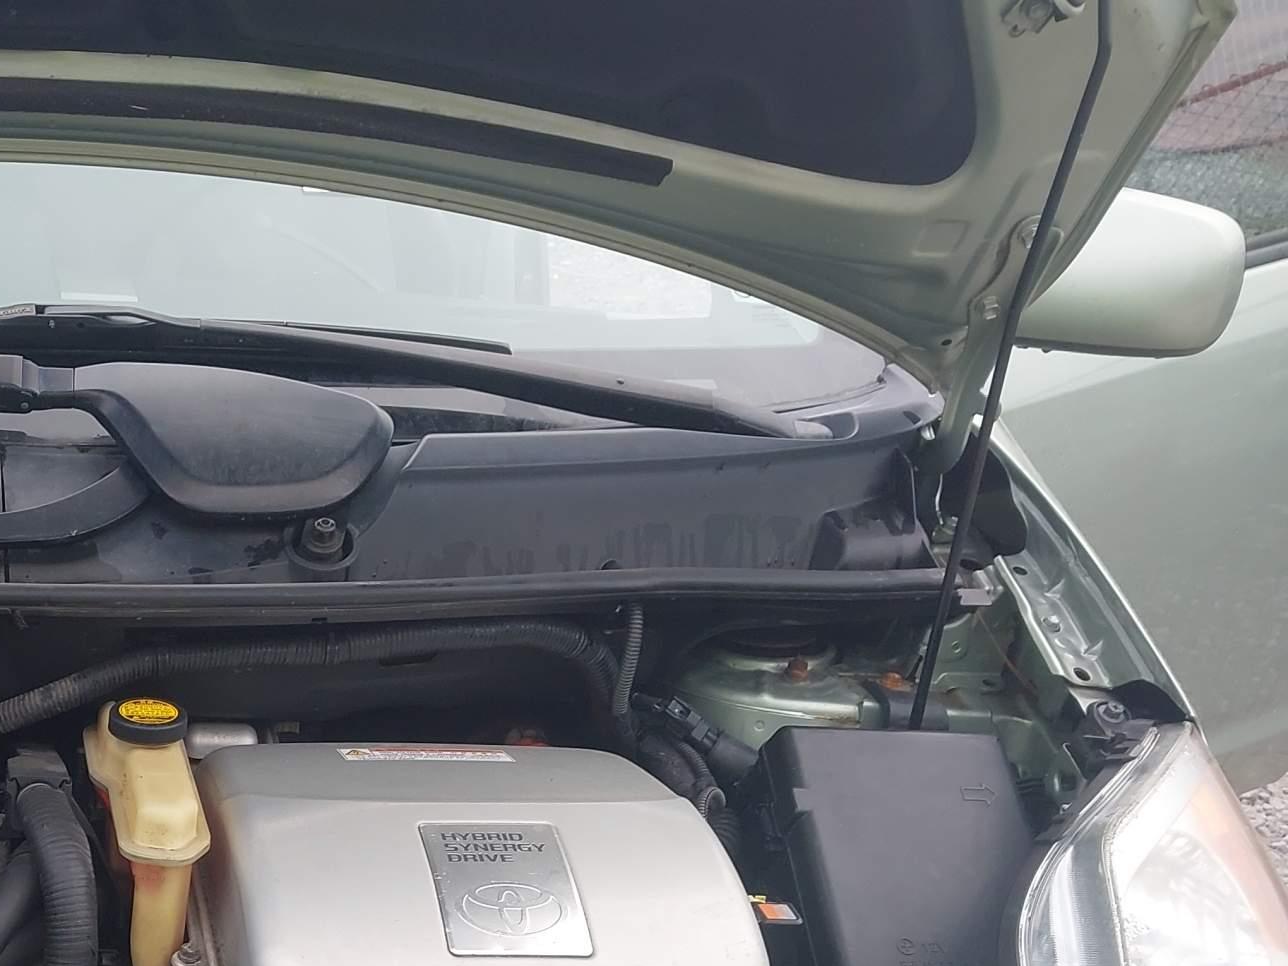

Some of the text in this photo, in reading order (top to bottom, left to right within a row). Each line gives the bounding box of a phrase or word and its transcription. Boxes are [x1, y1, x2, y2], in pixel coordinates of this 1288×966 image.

[440, 832, 524, 841] HYBRID
[444, 842, 546, 853] SYNERGY
[447, 853, 516, 863] DRIVE
